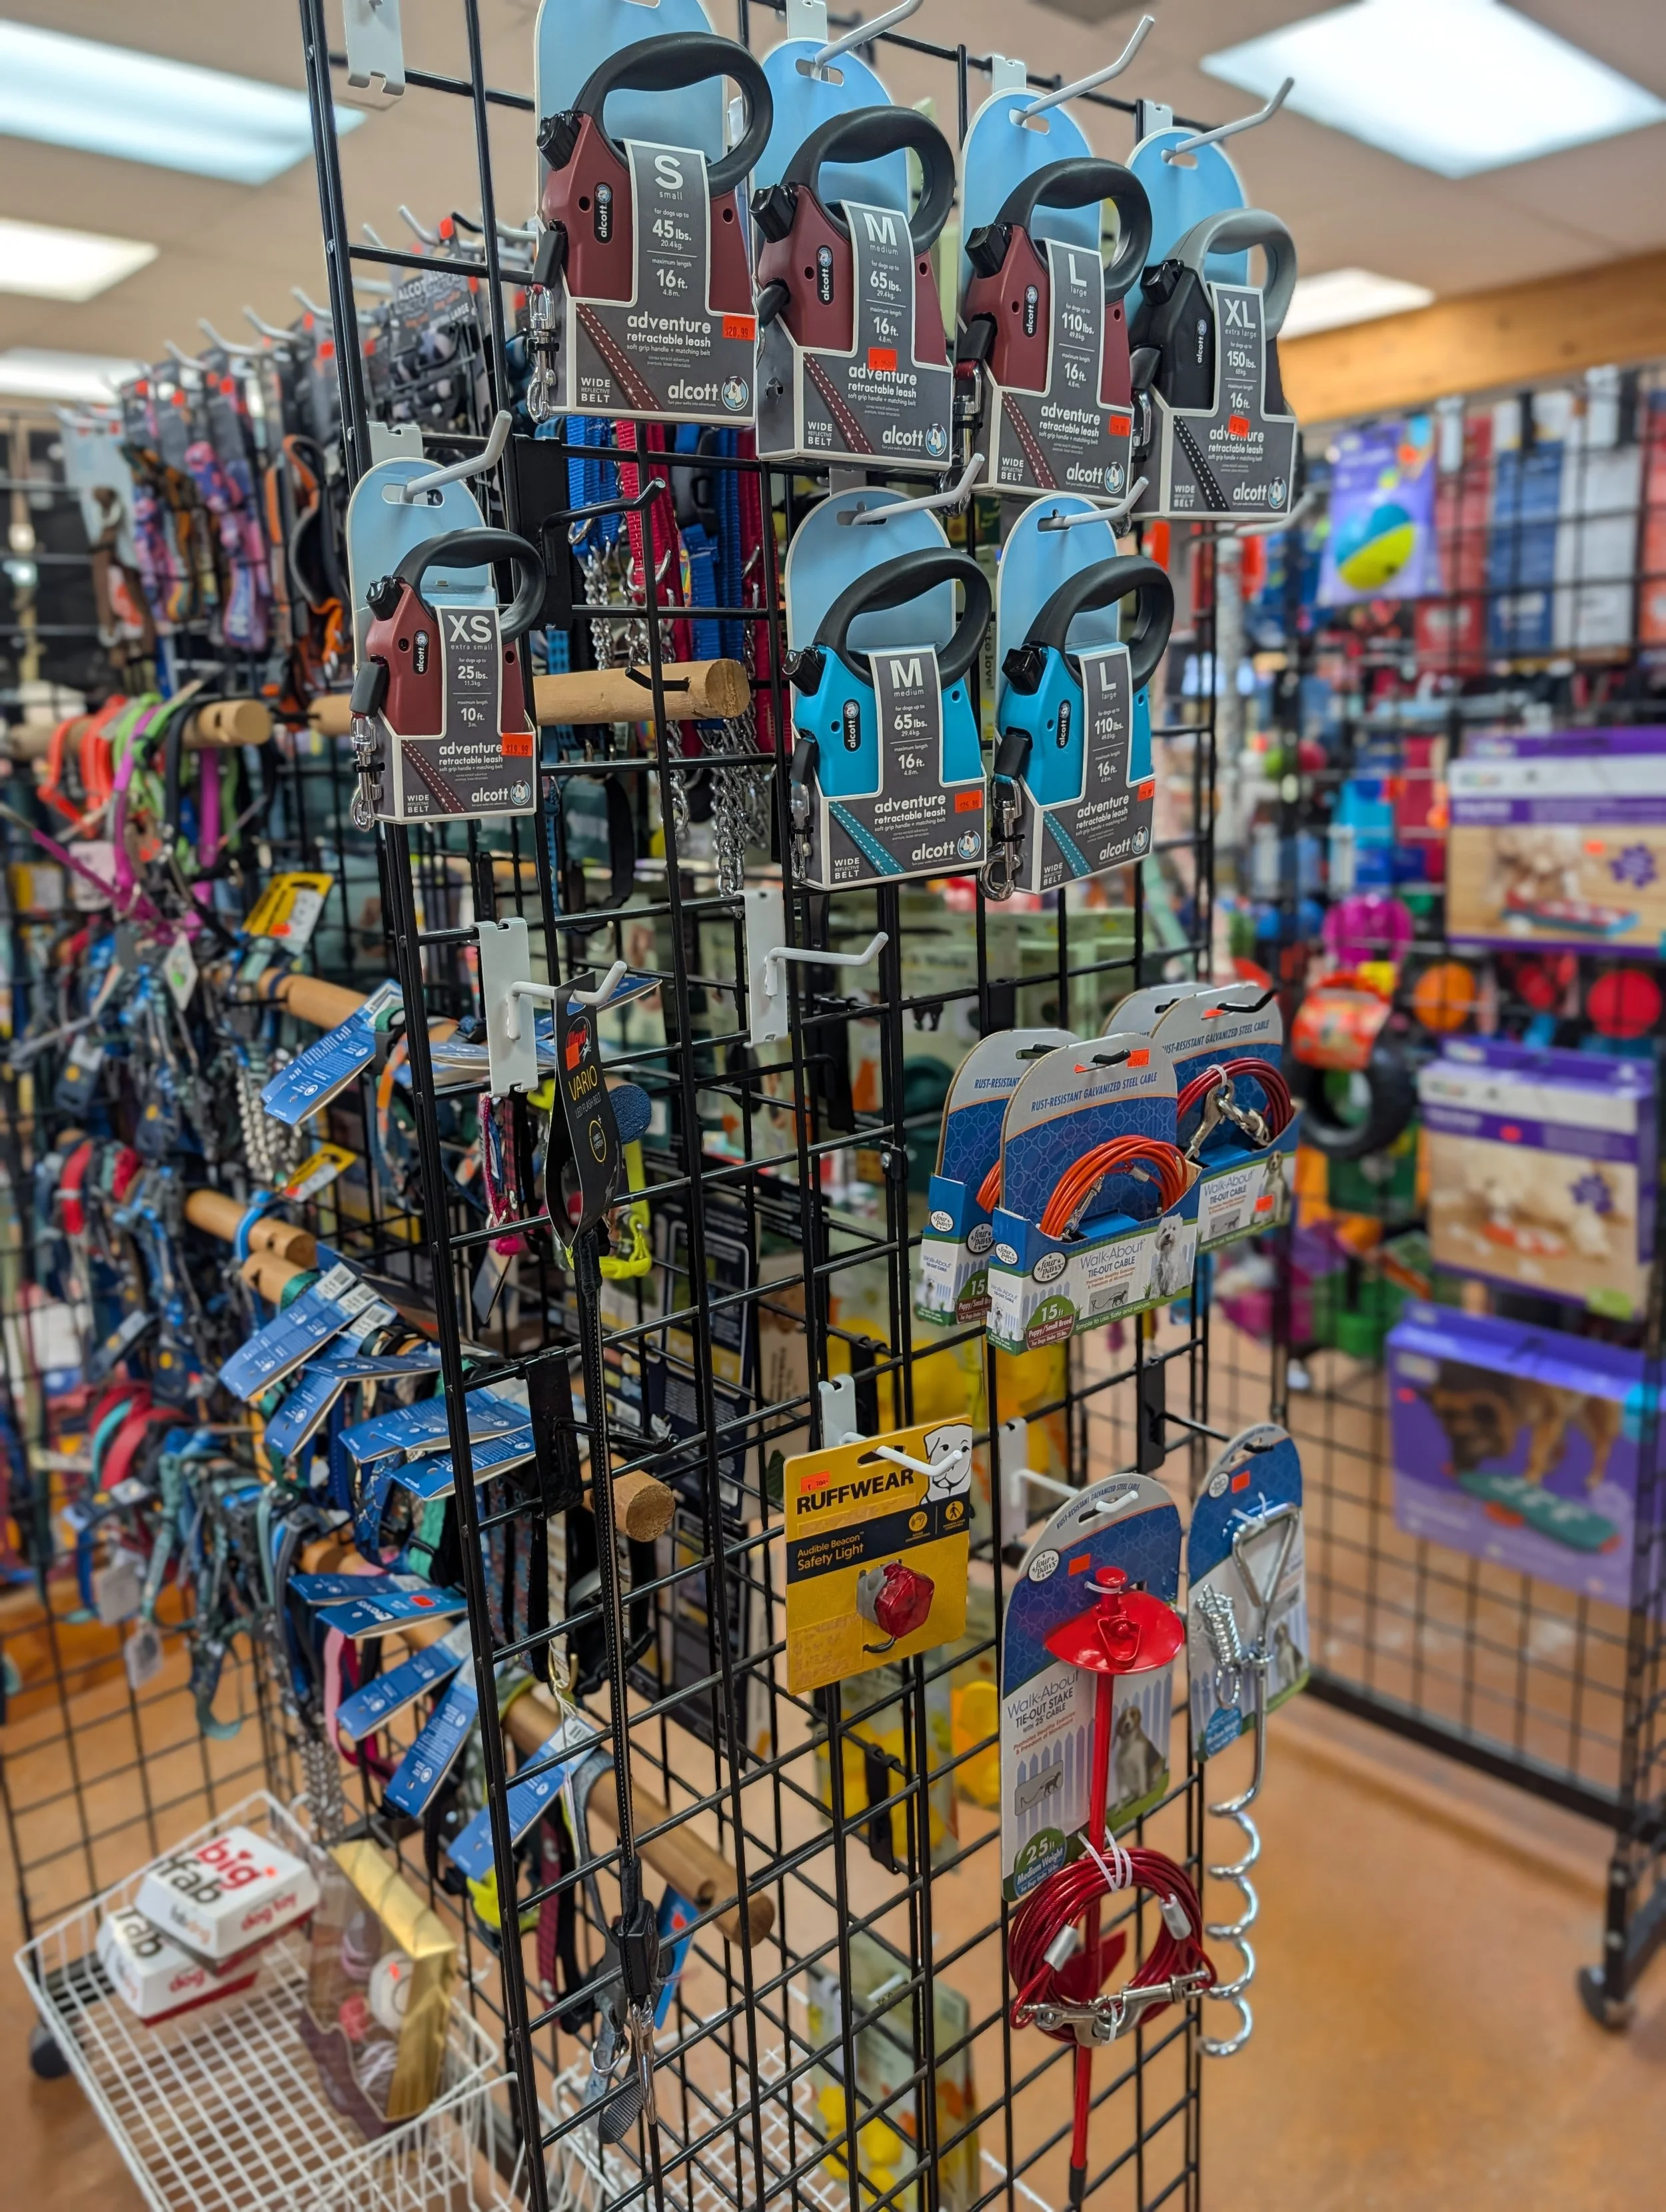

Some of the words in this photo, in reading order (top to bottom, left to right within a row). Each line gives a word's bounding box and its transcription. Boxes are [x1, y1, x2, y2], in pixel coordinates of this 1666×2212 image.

[654, 155, 683, 189] S
[660, 191, 682, 200] small
[598, 205, 608, 237] alcott
[863, 212, 897, 246] M
[870, 245, 898, 256] medium
[1068, 253, 1087, 287] L
[1070, 286, 1087, 297] large
[450, 302, 469, 320] LARGE
[1224, 298, 1256, 329] XL
[627, 311, 711, 334] adventure
[626, 332, 682, 345] retractable
[685, 336, 710, 348] leash
[1242, 329, 1257, 339] large
[676, 347, 699, 356] matching
[581, 377, 610, 388] WIDE
[849, 362, 917, 386] adventure
[581, 394, 609, 403] BELT
[668, 379, 718, 401] alcott
[848, 382, 894, 396] retractable
[896, 386, 916, 398] leash
[1041, 402, 1100, 426] adventure
[808, 421, 832, 432] WIDE
[882, 425, 923, 446] alcott
[1040, 421, 1079, 434] retractable
[1081, 426, 1100, 437] leash
[808, 437, 832, 446] BELT
[1002, 457, 1024, 467] WIDE
[1001, 472, 1023, 482] BELT
[1067, 462, 1102, 484] alcott
[1234, 482, 1266, 501] alcott
[448, 615, 492, 643] XS
[890, 658, 923, 689] M
[1100, 662, 1116, 692] L
[894, 689, 924, 698] medium
[438, 742, 502, 756] adventure
[438, 757, 482, 766] retractable
[472, 787, 508, 803] alcott
[874, 794, 946, 814] adventure
[874, 811, 922, 825] retractable
[924, 807, 946, 818] leash
[1078, 795, 1129, 819] adventure
[912, 841, 955, 861] alcott
[1100, 837, 1131, 860] alcott
[834, 857, 860, 866] WIDE
[834, 869, 859, 879] BELT
[1206, 1028, 1238, 1043] GALVANIZED
[1239, 1024, 1253, 1035] STEEL
[1254, 1019, 1269, 1031] CABLE
[568, 1065, 598, 1101] VARIO
[1031, 1090, 1082, 1112] RUST-RESISTANT
[1084, 1080, 1121, 1099] GALVANIZED
[1123, 1078, 1138, 1089] STEEL
[1140, 1072, 1158, 1084] CABLE
[1210, 1191, 1229, 1204] TIE-OUT
[974, 1229, 988, 1240] four
[974, 1237, 991, 1249] paws
[999, 1246, 1013, 1256] four
[1002, 1252, 1016, 1262] paws
[1040, 1258, 1057, 1271] four
[1042, 1265, 1061, 1278] paws
[1088, 1264, 1113, 1278] TIE-OUT
[1114, 1257, 1136, 1269] CABLE
[972, 1279, 986, 1295] 15
[1042, 1303, 1058, 1321] 15
[1028, 1319, 1058, 1337] Puppy/Small
[1059, 1317, 1072, 1326] Breed
[1076, 1321, 1093, 1331] Simple
[797, 1468, 914, 1515] RUFFWEAR
[1056, 1496, 1090, 1529] RUST-RESISTANT
[1091, 1485, 1116, 1500] GALVANIZED
[797, 1539, 829, 1558] Audible
[798, 1552, 832, 1571] Safety
[836, 1543, 864, 1560] Light
[1035, 1556, 1051, 1570] four
[1037, 1560, 1056, 1578] paws
[1008, 1669, 1080, 1719] Walk-About
[1016, 1702, 1046, 1728] TIE-OUT
[1049, 1687, 1074, 1709] STAKE
[1023, 1722, 1034, 1732] WITH
[1046, 1702, 1066, 1719] CABLE
[1026, 1836, 1048, 1866] 25
[193, 1838, 260, 1890] big
[241, 1908, 273, 1932] dog
